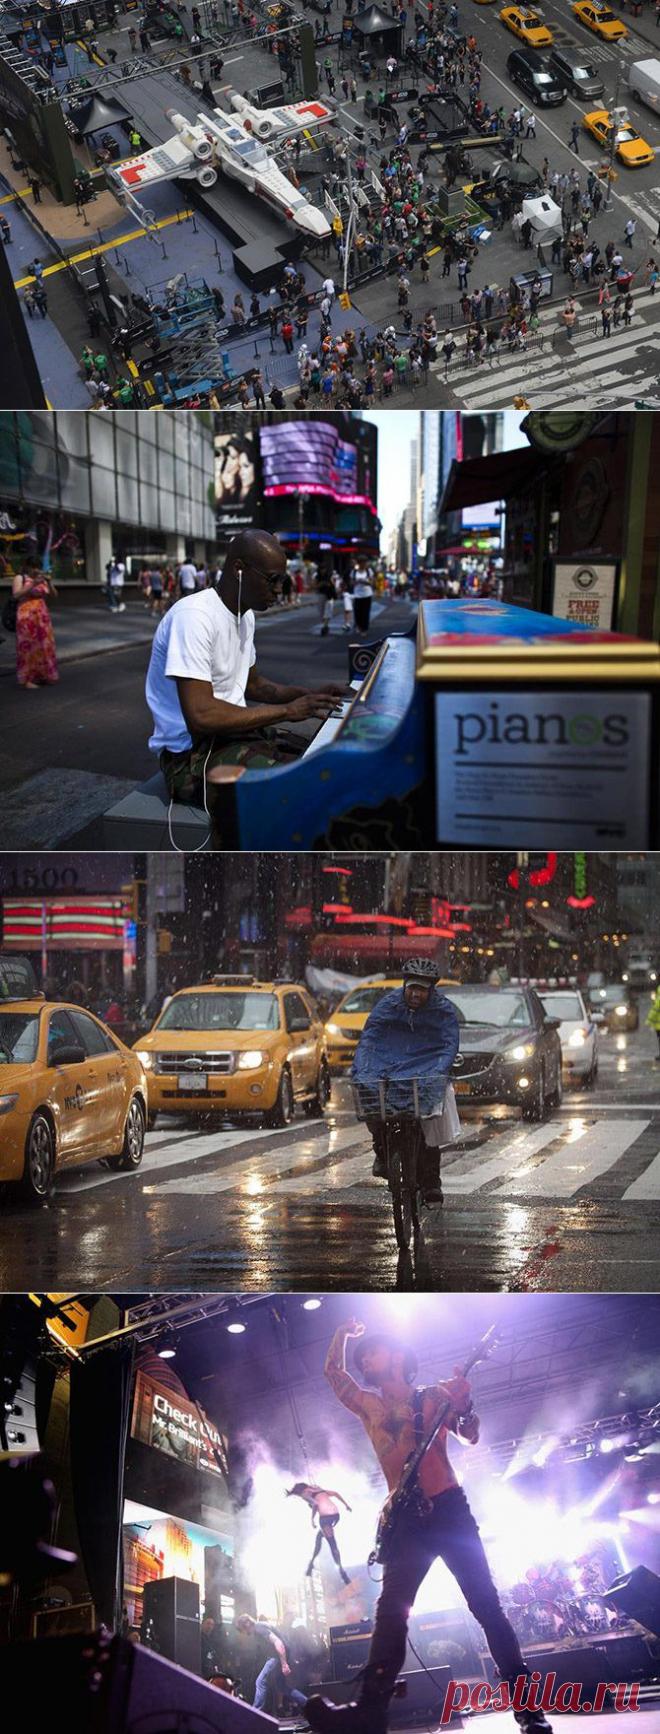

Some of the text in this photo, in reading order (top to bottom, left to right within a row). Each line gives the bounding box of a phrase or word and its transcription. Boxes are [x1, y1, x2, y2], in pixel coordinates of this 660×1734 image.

[453, 702, 630, 755] pianos
[10, 868, 78, 889] 1500
[152, 1414, 168, 1430] Mr.
[153, 1394, 198, 1431] Check
